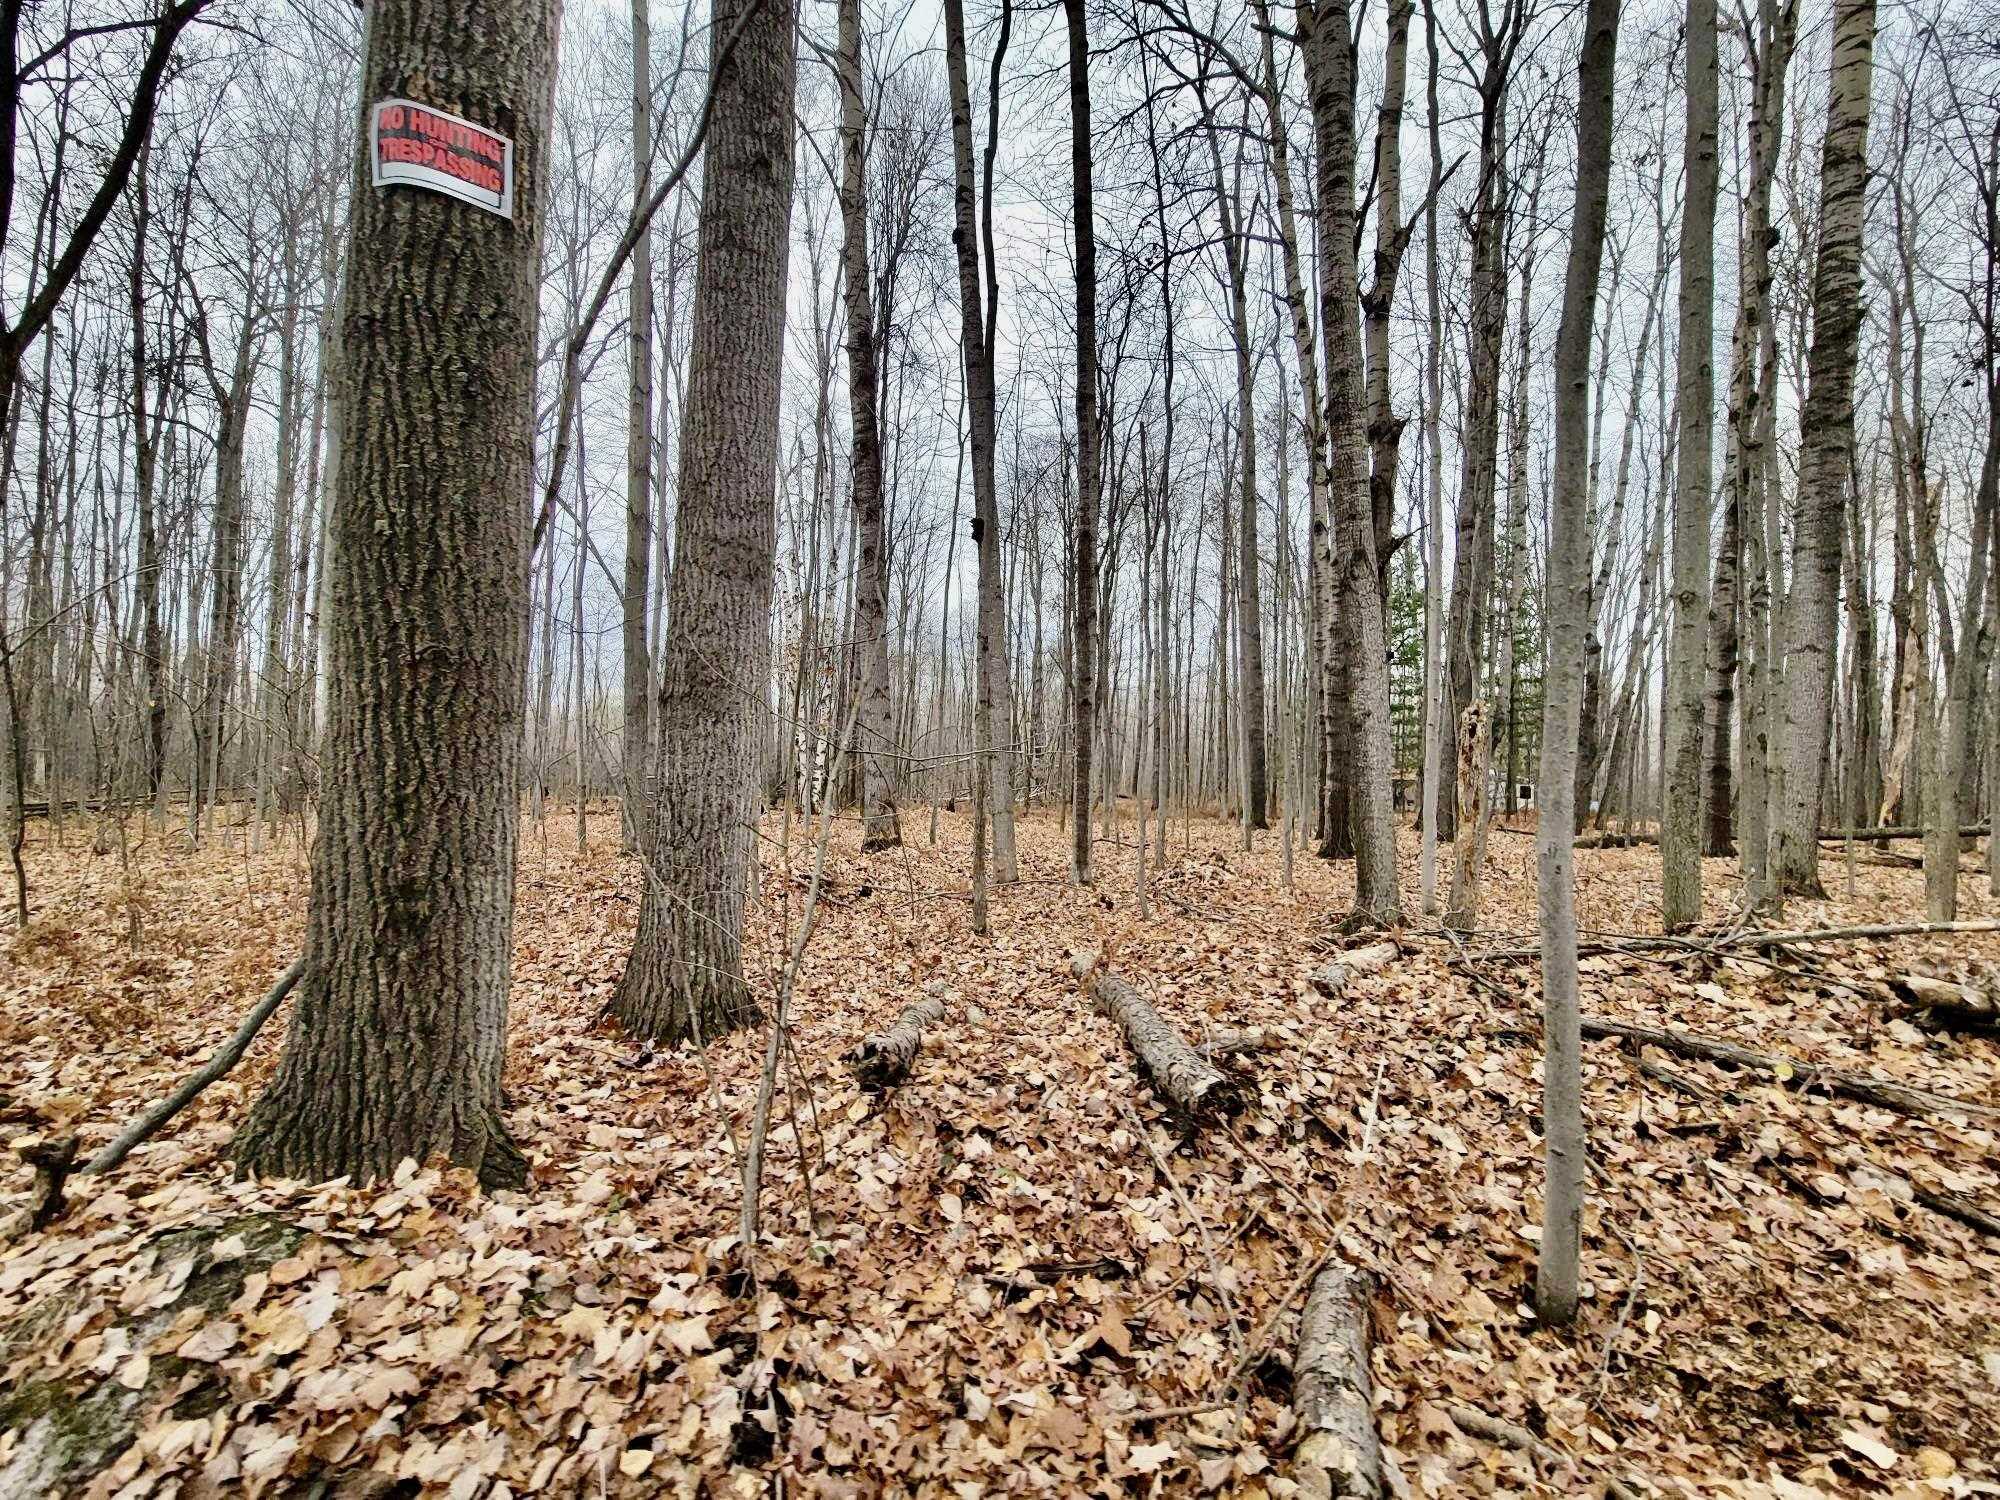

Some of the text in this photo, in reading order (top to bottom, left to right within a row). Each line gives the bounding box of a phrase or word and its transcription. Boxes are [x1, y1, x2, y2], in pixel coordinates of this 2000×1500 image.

[380, 106, 503, 164] NO HUNTING
[380, 137, 501, 191] TRESPASSING
